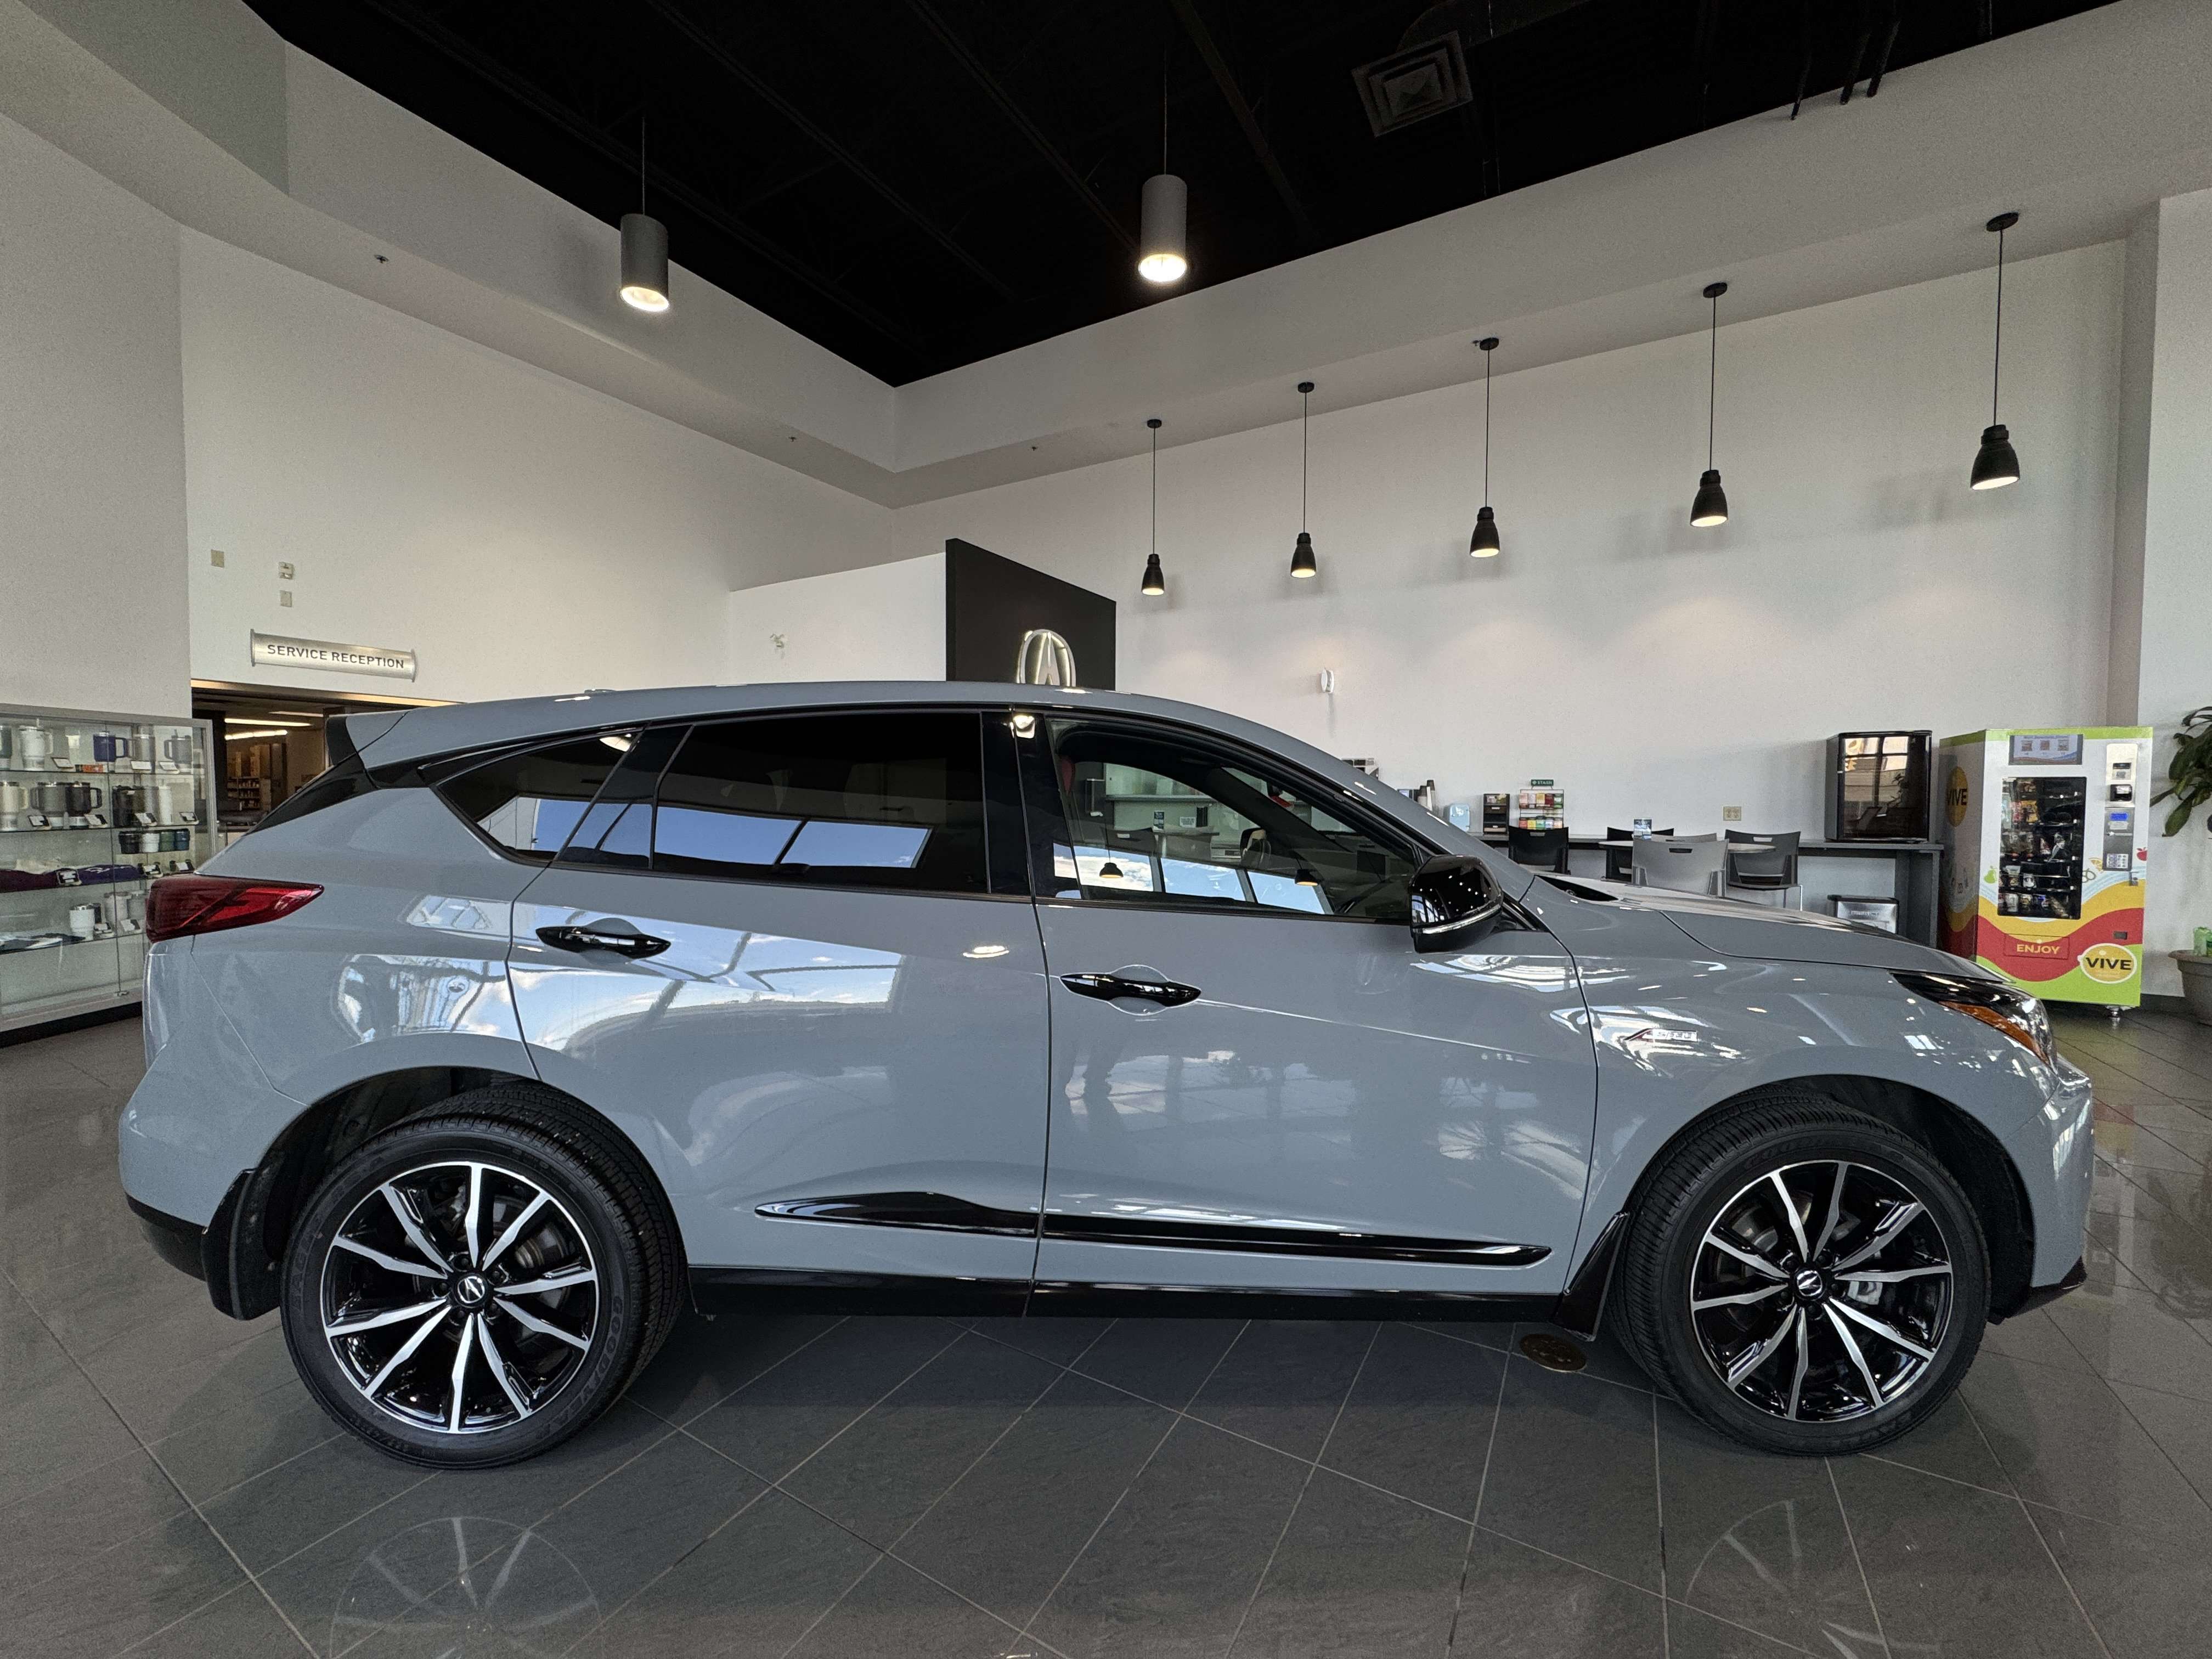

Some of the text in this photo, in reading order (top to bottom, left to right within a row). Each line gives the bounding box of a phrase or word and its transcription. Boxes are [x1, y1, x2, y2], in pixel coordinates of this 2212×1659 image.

[267, 644, 404, 669] SERVICE RECEPTION
[1946, 788, 1967, 806] VIVE
[2016, 944, 2061, 955] ENJOY
[2085, 957, 2132, 970] VIVE
[535, 1295, 623, 1440] GOODYEAR
